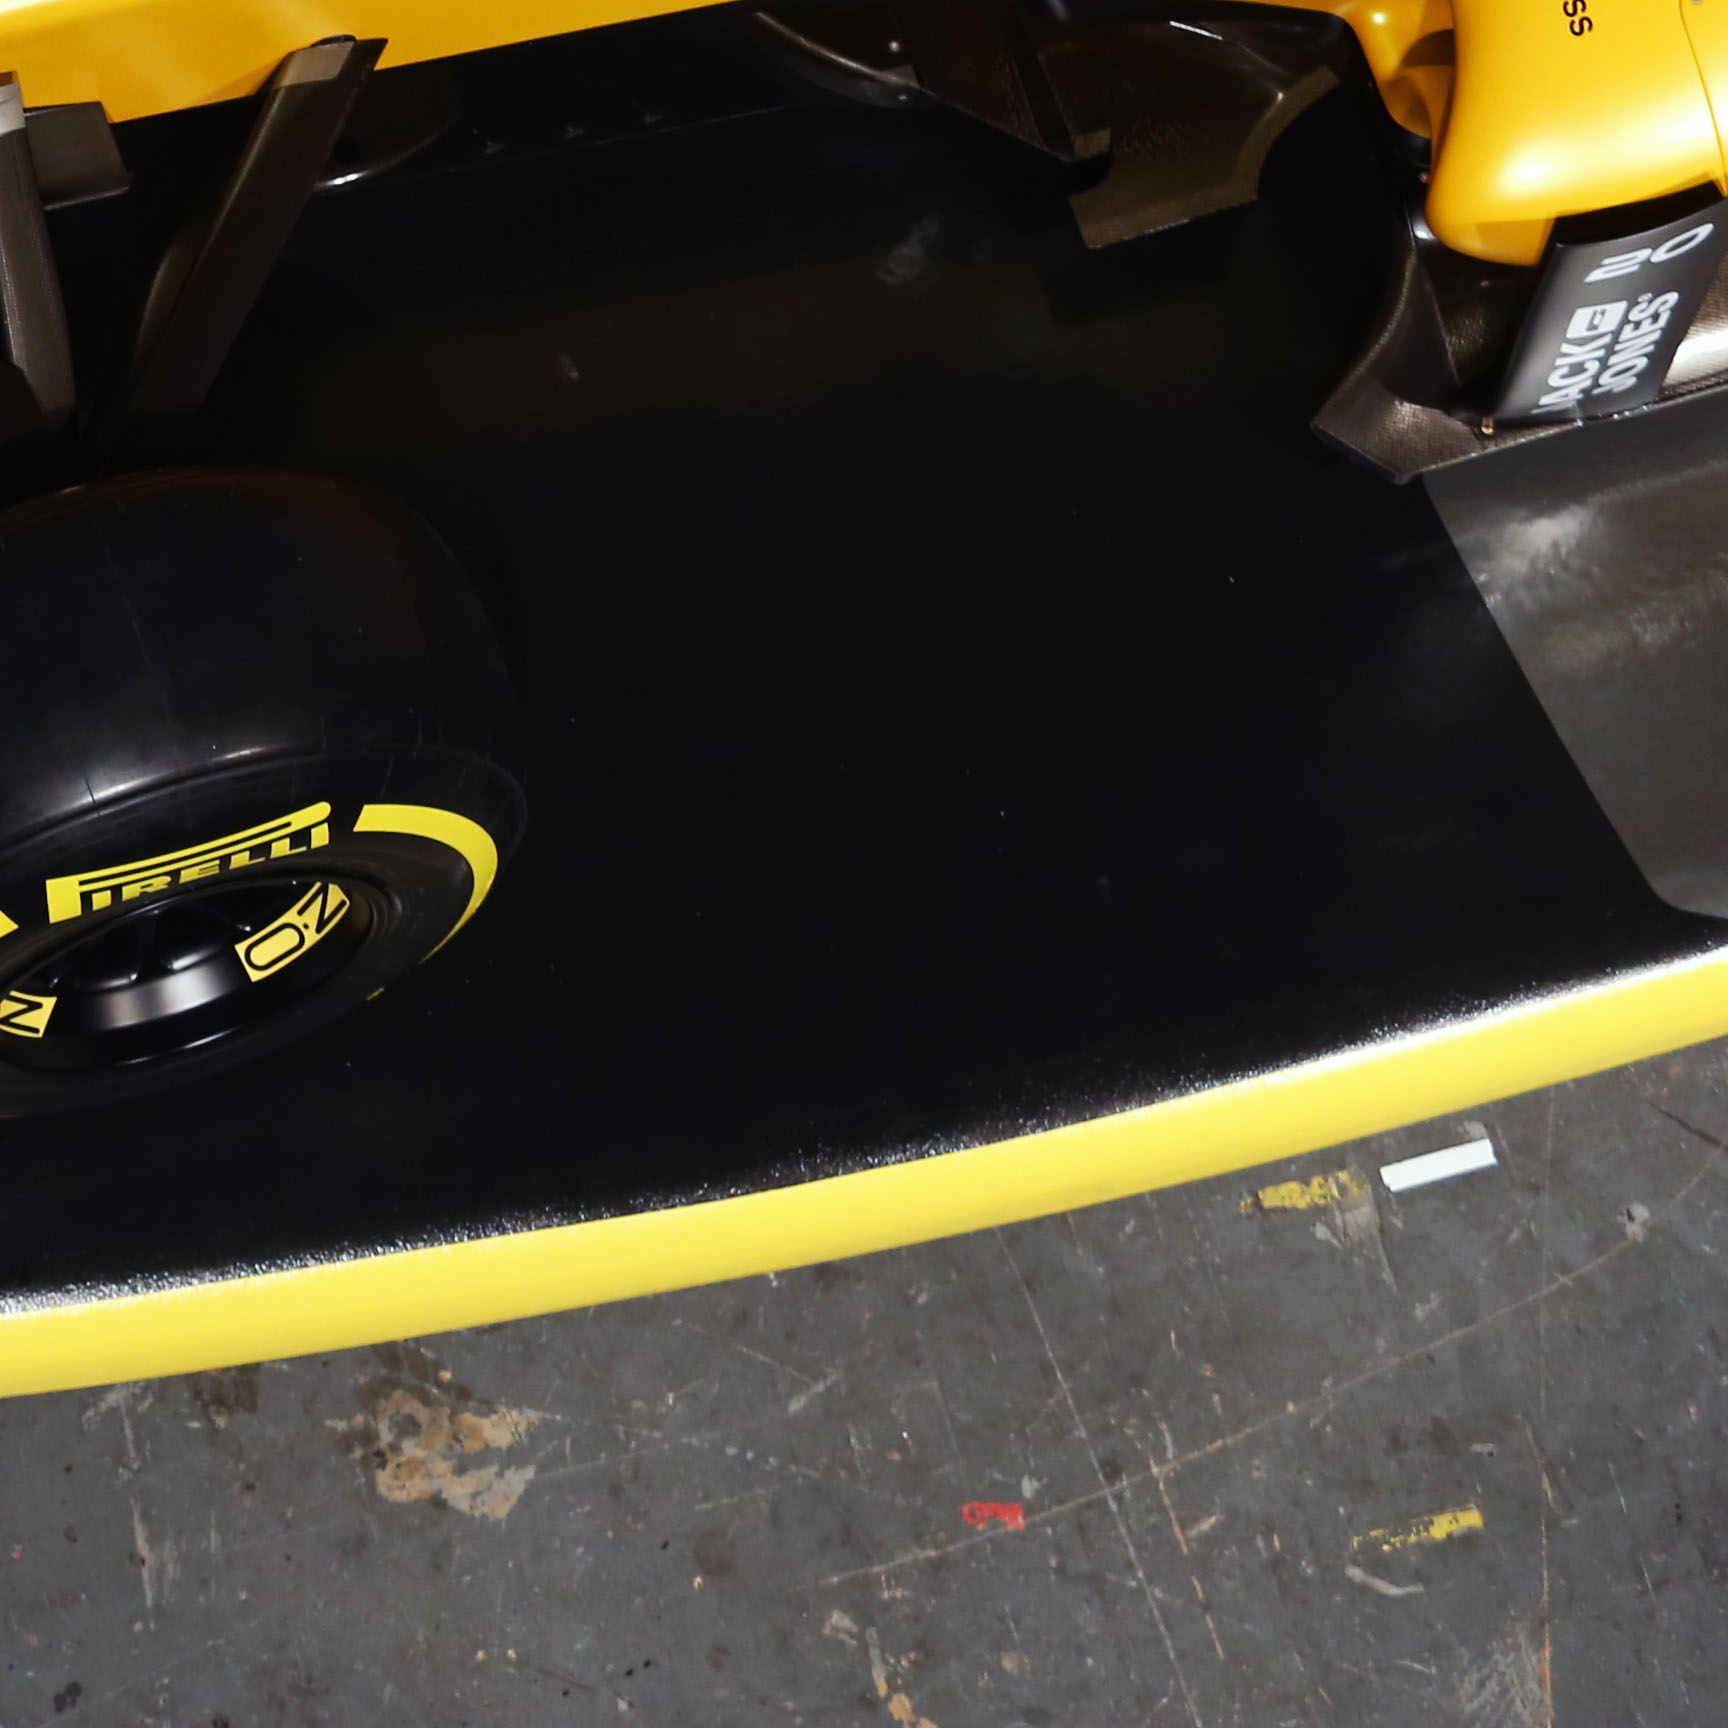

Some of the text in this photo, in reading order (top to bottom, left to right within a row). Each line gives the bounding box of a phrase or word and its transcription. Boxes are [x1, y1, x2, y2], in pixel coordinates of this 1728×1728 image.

[1583, 223, 1714, 284] 20
[1591, 290, 1680, 396] JONES
[45, 801, 332, 924] PIRELLI
